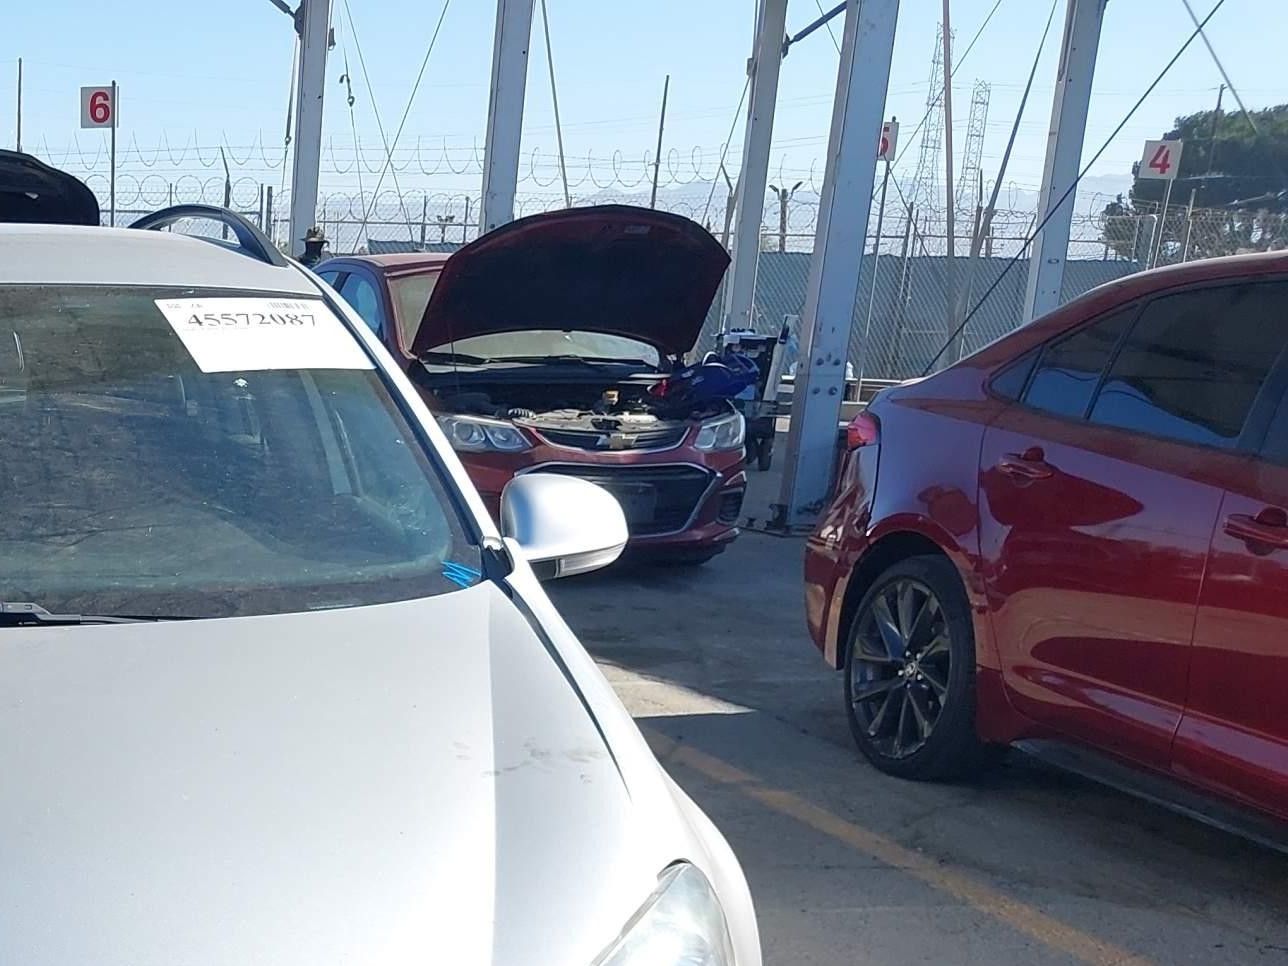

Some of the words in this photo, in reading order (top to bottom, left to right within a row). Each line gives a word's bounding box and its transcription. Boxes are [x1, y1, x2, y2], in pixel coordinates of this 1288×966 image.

[89, 91, 111, 124] 6
[1148, 145, 1171, 175] 4
[188, 313, 316, 327] 45572087
